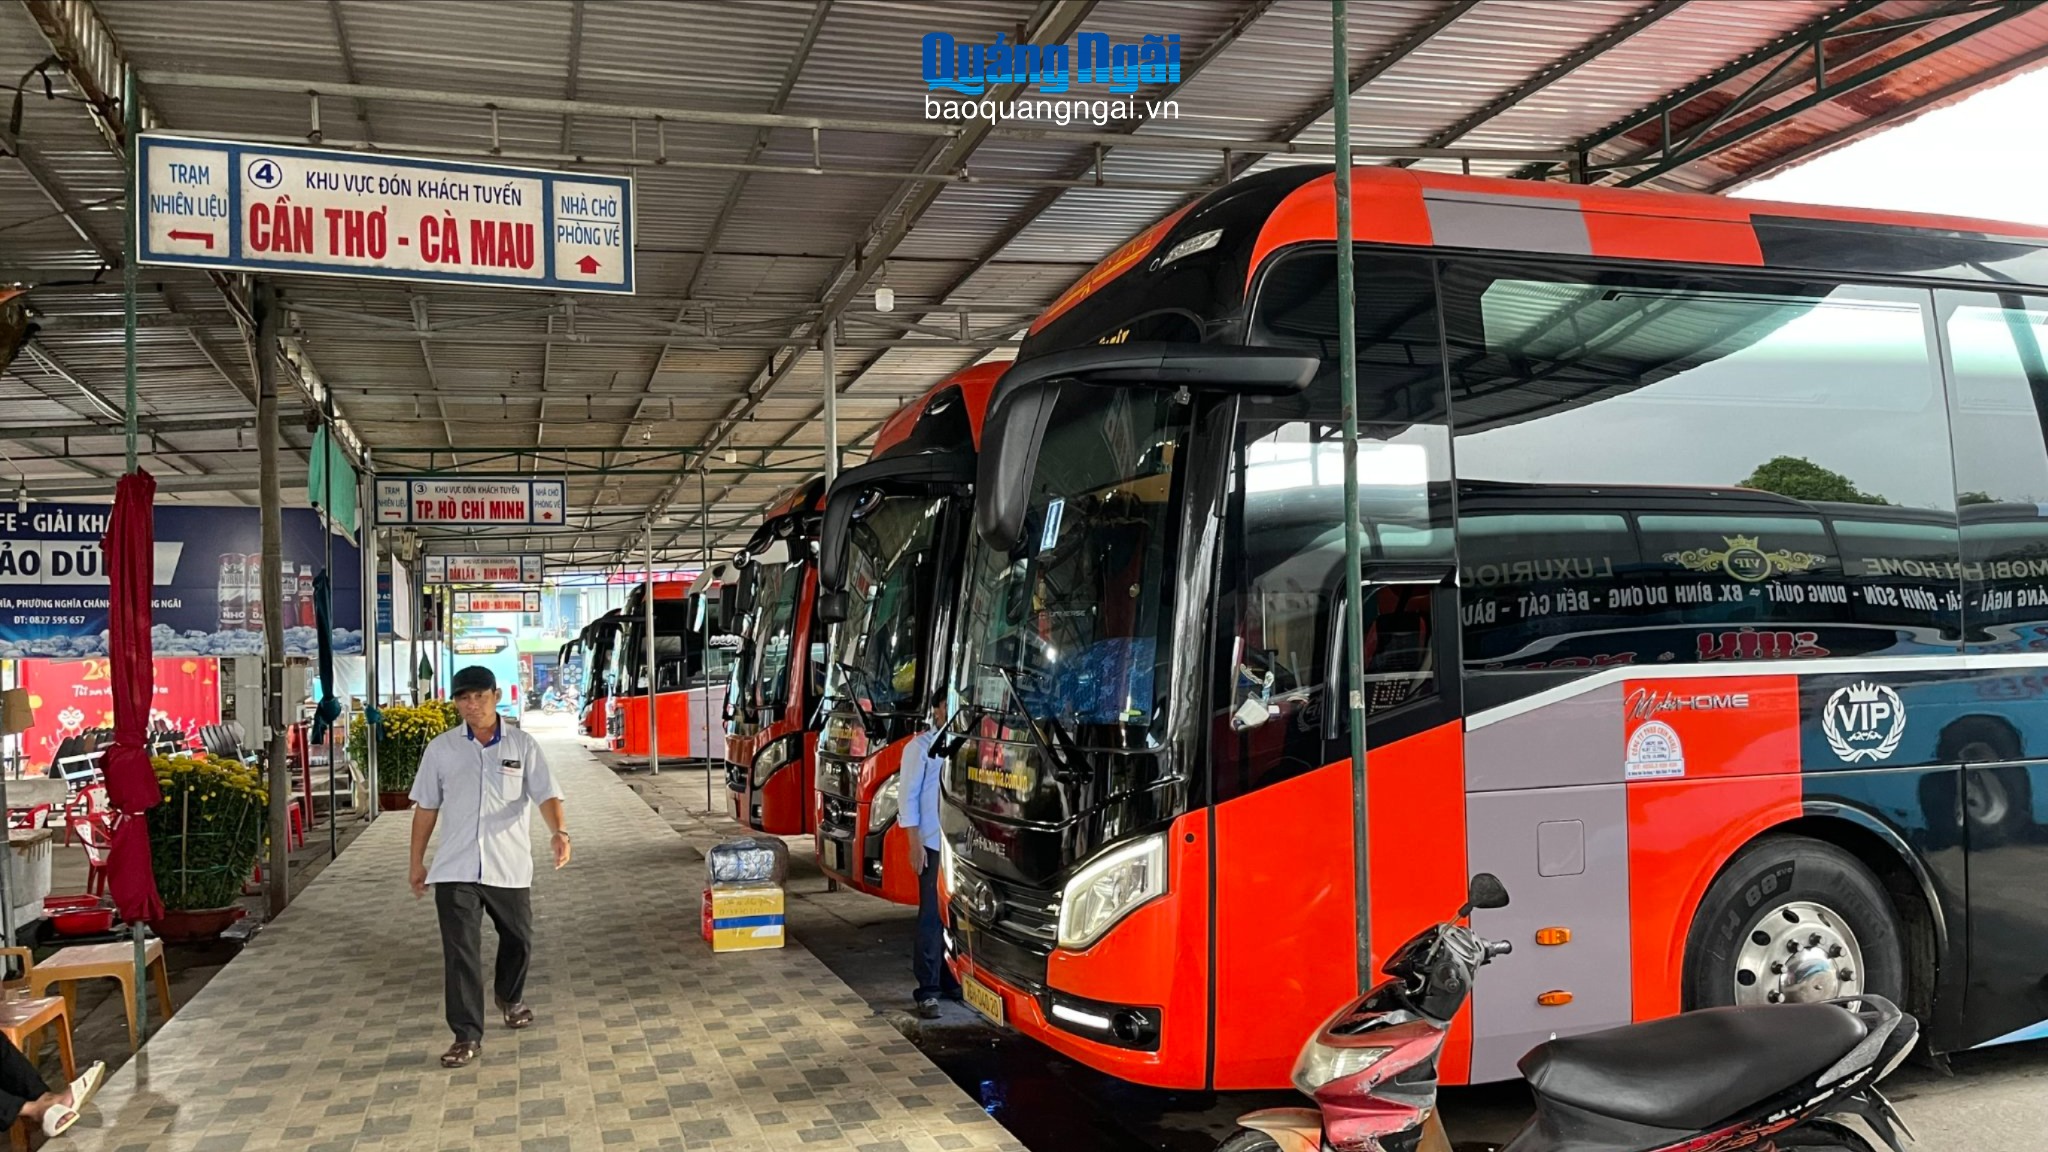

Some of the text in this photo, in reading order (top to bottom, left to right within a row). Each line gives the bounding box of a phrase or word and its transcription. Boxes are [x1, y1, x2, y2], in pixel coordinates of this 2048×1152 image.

[169, 163, 210, 187] TRẠM
[254, 163, 274, 184] 4
[306, 170, 522, 206] KHU VỰC ĐÓN KHÁCH TUYẾN
[150, 191, 228, 222] NHIÊN LIỆU
[560, 194, 618, 219] NHÀ CHỜ
[249, 194, 315, 257] CẦN
[324, 207, 388, 260] THƠ
[420, 210, 463, 264] CÀ
[470, 218, 535, 270] MAU
[557, 218, 621, 248] PHÒNG VÉ
[435, 486, 448, 494] KHU
[478, 486, 499, 494] KHÁCH
[500, 485, 520, 494] TUYẾN
[416, 495, 525, 520] TP. HỒ CHÍ MINH
[33, 509, 73, 533] GIẢI
[52, 544, 110, 577] DŨ
[17, 598, 53, 609] PHƯỜNG
[55, 599, 81, 608] NGHĨA
[29, 616, 50, 624] 0827
[69, 616, 85, 625] 657
[1836, 702, 1891, 732] VIP
